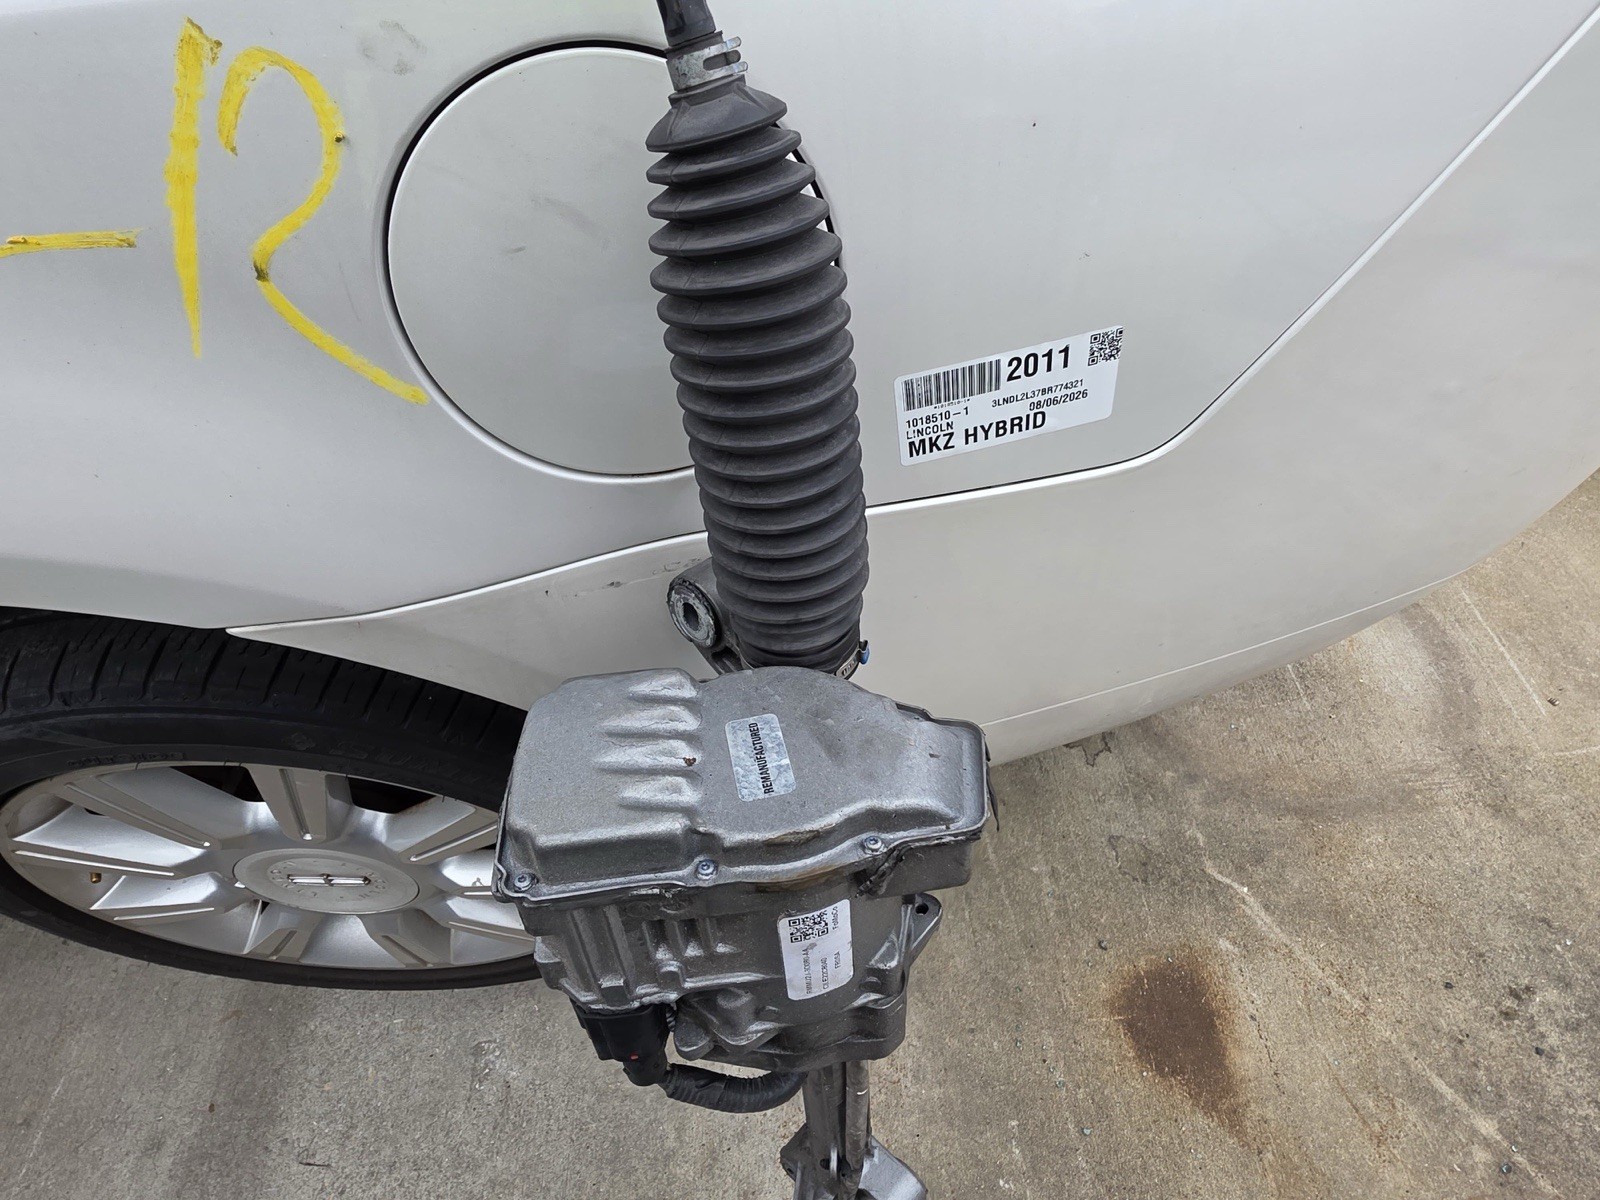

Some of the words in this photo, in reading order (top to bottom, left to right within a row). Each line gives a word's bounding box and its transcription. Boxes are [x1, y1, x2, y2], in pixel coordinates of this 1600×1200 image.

[1006, 343, 1071, 382] 2011
[991, 378, 1084, 408] 3LNDL2L37BR774321
[1028, 389, 1089, 411] 08/06/2026
[906, 421, 954, 440] LINCOLN
[908, 432, 955, 458] MKZ
[964, 410, 1046, 445] HYBRID
[748, 722, 775, 795] REMANUFACTURED
